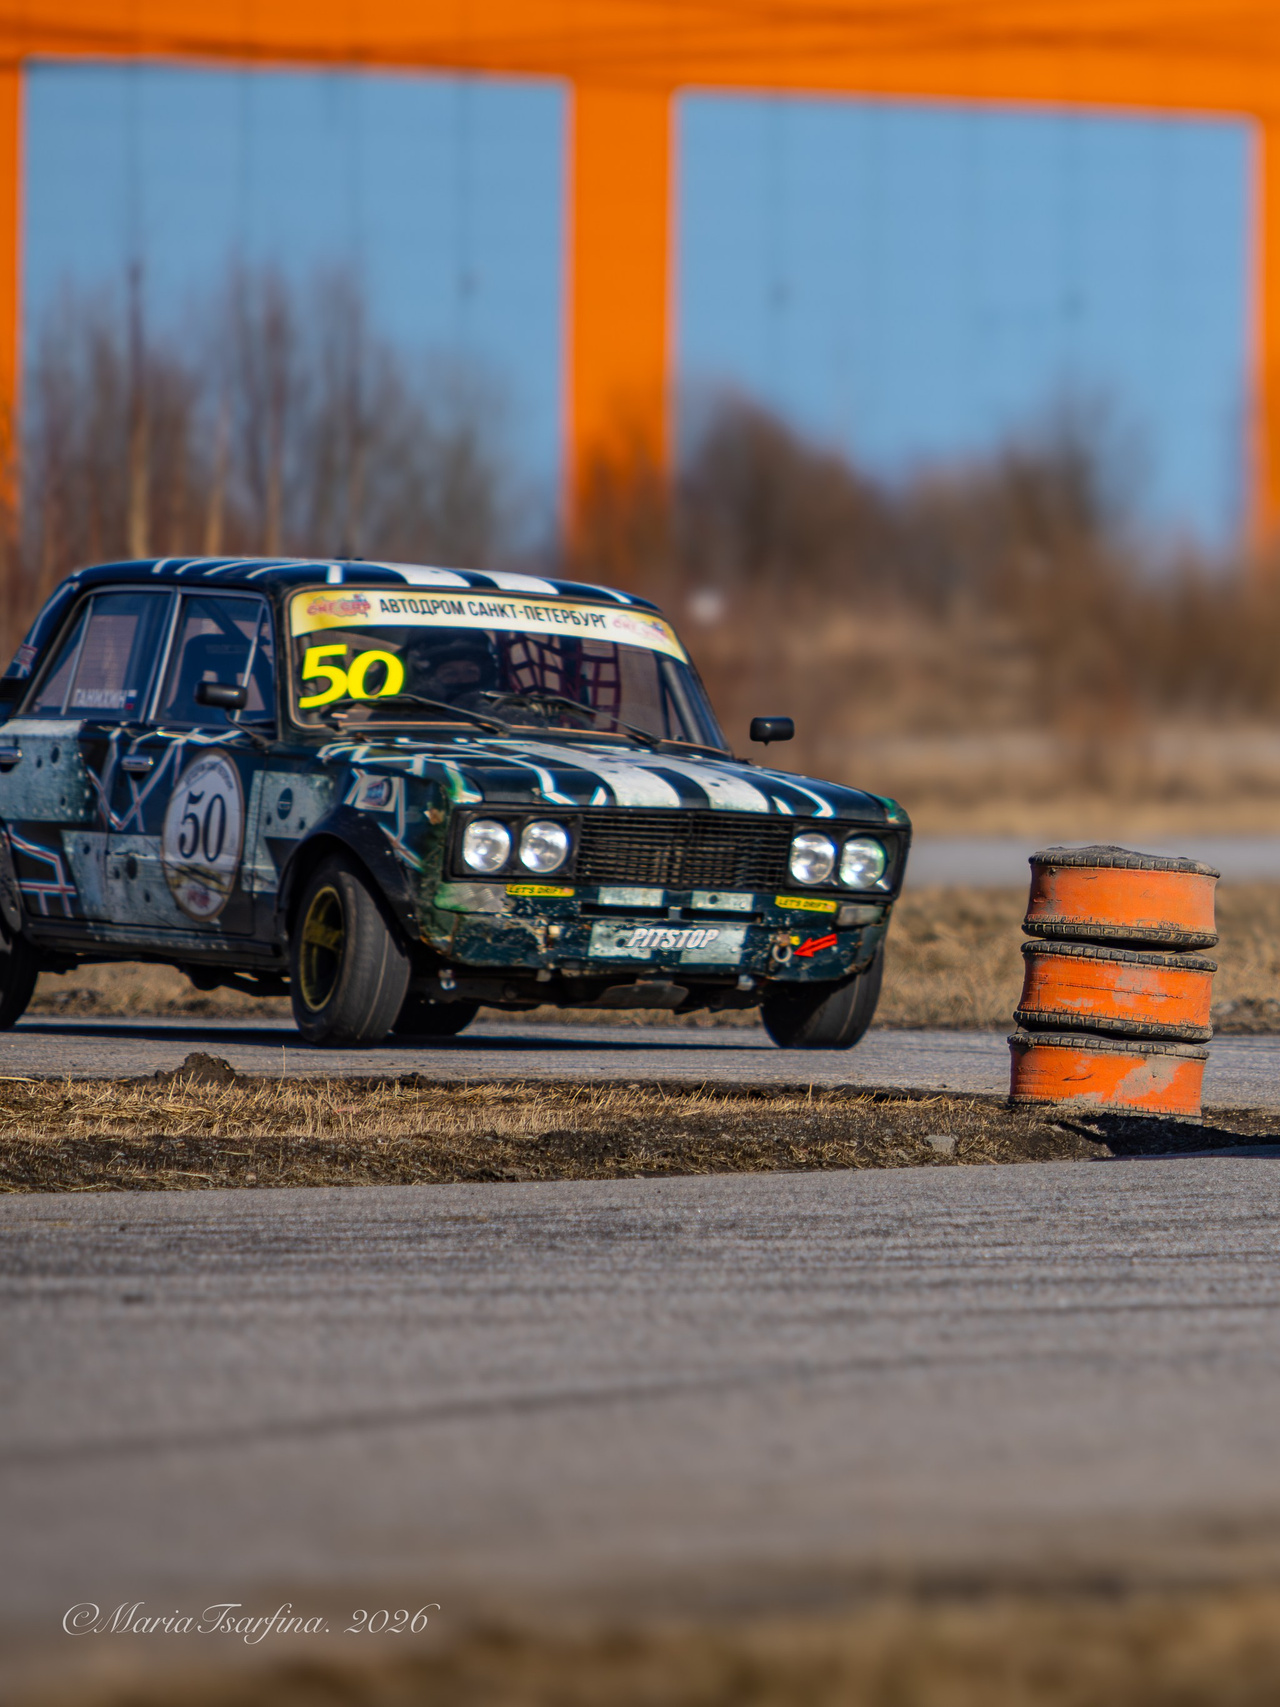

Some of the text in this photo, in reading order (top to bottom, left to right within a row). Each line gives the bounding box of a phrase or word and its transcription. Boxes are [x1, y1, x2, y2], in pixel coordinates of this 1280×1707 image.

[379, 598, 606, 629] АВТОДРОМ САНКТ-ПЕТЕРБУРГ
[299, 643, 404, 709] 50
[178, 790, 227, 863] 50
[625, 927, 720, 950] PITSTOP
